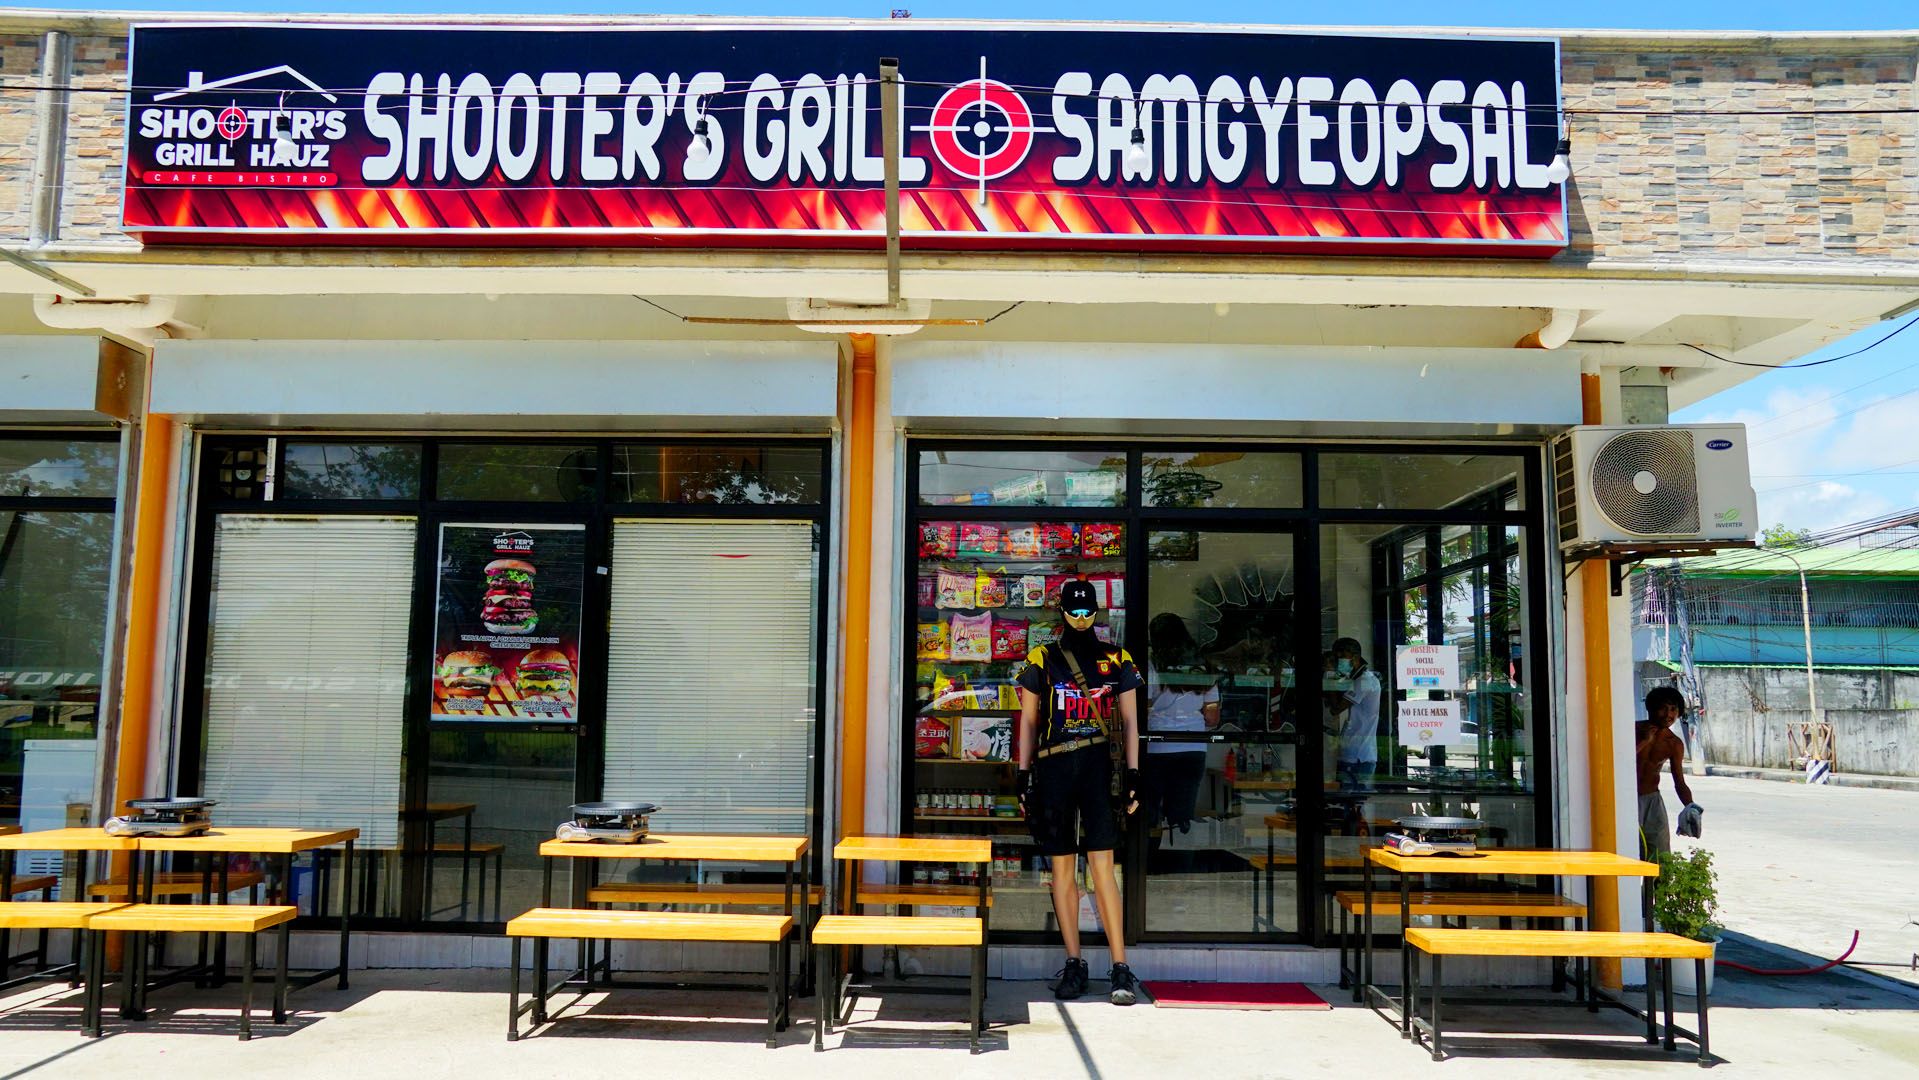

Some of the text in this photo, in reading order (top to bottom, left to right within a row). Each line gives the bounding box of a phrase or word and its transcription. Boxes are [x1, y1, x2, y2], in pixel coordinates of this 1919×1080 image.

[361, 71, 1551, 189] SHOOTER'S GRILL SAMGYEOPSAL
[155, 143, 235, 167] GRILL
[154, 173, 327, 184] CAFE BISTRO
[1410, 646, 1439, 654] OBSERVE
[1406, 667, 1445, 676] DISTANCING
[1401, 708, 1448, 716] NO FACE MASK
